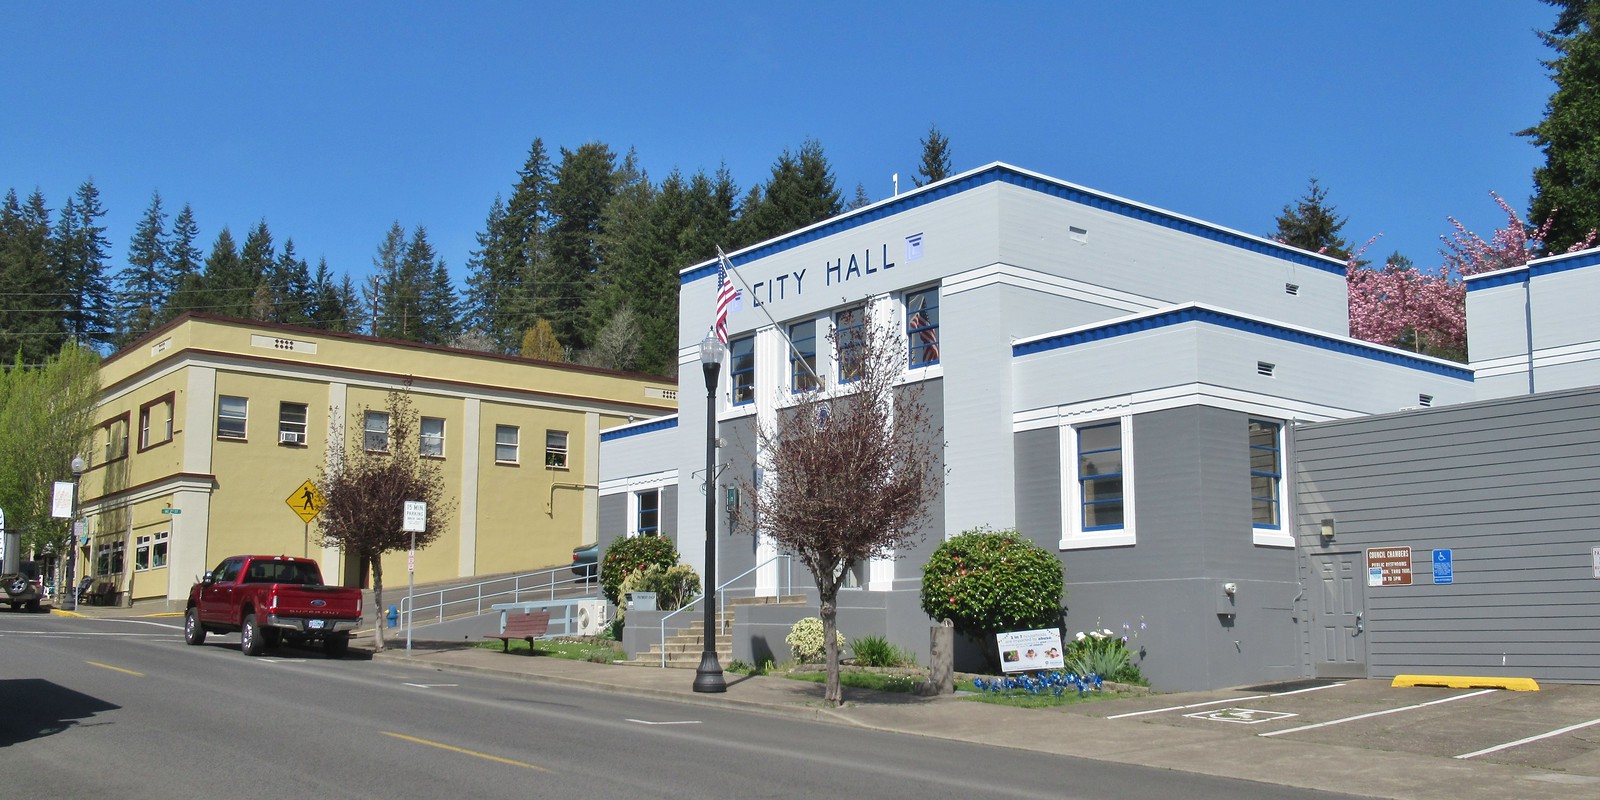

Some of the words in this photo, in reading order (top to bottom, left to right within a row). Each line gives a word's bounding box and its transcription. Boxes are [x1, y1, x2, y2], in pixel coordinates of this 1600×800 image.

[753, 268, 806, 307] CITY
[826, 244, 895, 286] HALL
[1387, 550, 1409, 558] CHAMBERS
